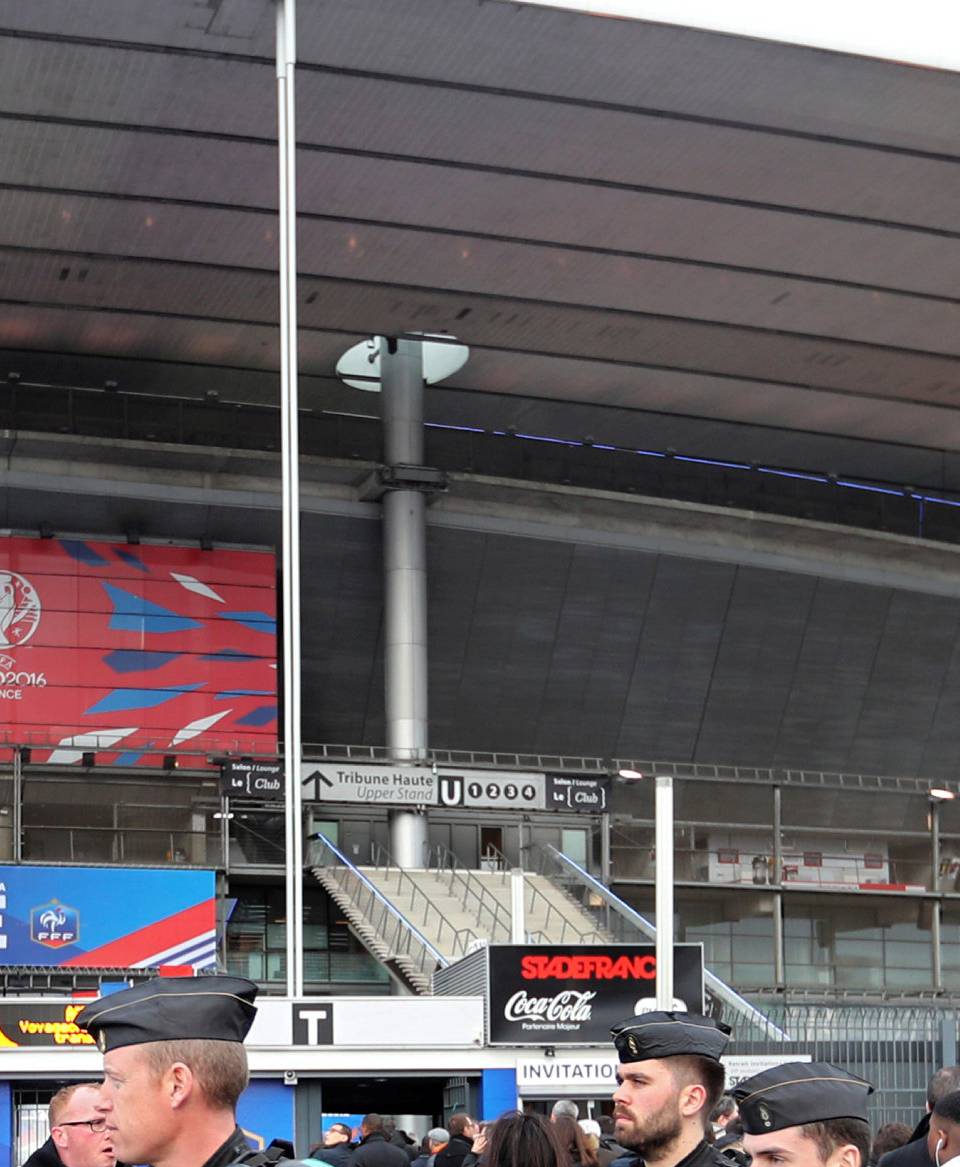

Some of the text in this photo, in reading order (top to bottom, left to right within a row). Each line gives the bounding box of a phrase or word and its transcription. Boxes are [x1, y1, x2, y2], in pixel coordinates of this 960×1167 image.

[231, 778, 243, 787] Le
[254, 777, 280, 790] Club
[337, 771, 433, 787] Tribune Haute
[357, 786, 433, 801] Upper Stand
[440, 780, 462, 806] U
[574, 791, 599, 804] Club
[521, 955, 657, 980] STADEFRANC
[504, 990, 597, 1022] Coca-Cola
[299, 1010, 327, 1046] T
[522, 1022, 580, 1032] Partenaire Majeur
[523, 1063, 618, 1079] INVITATIO
